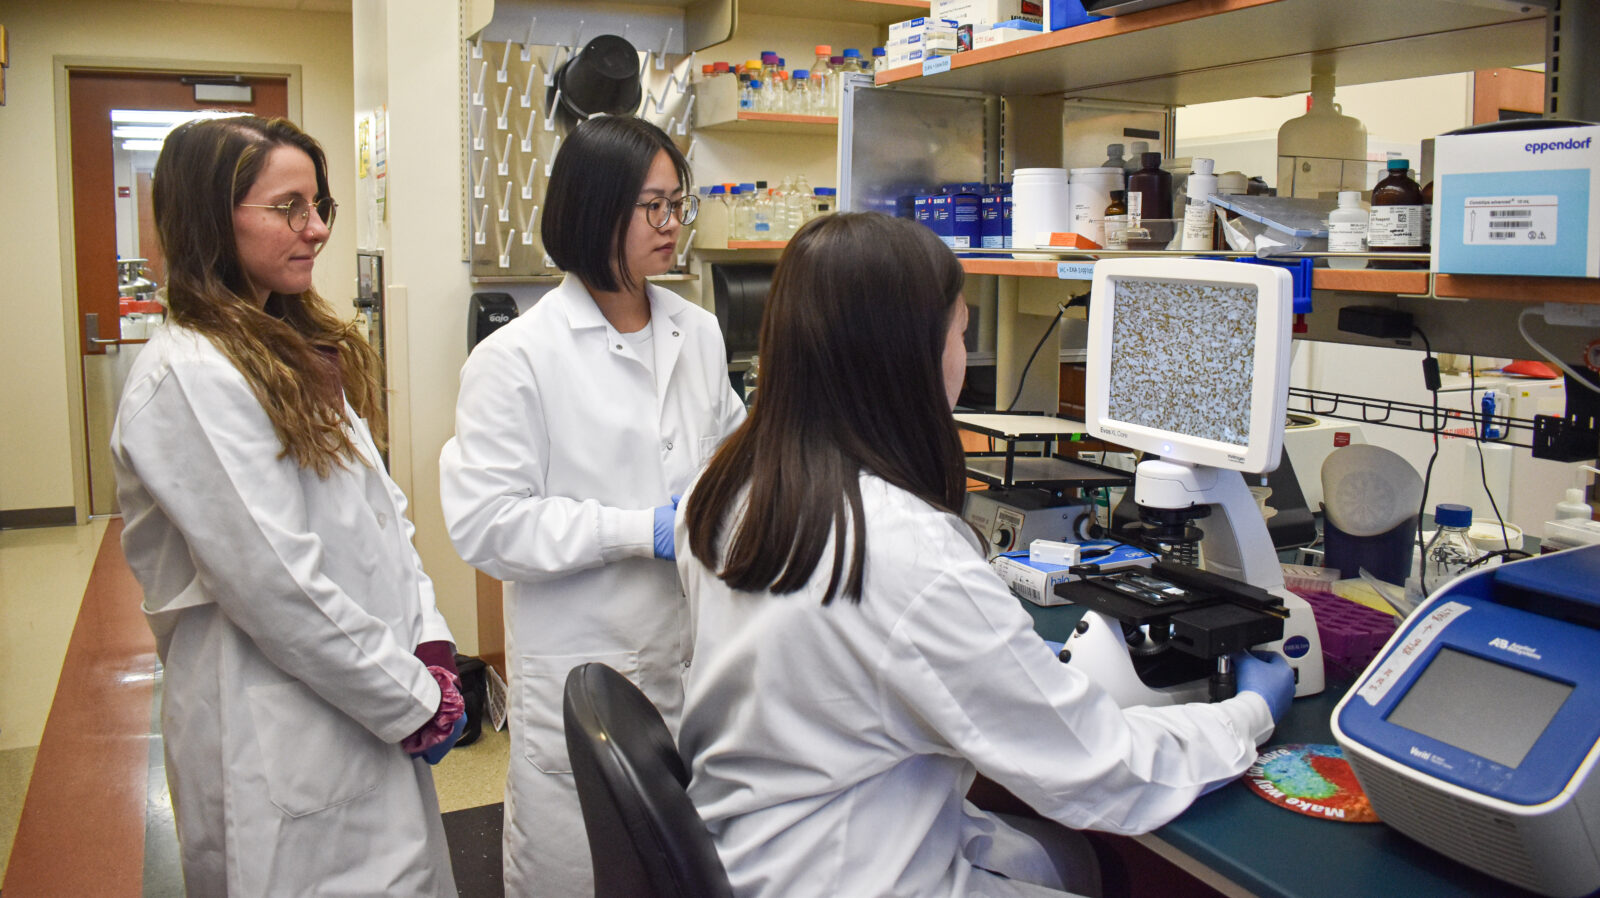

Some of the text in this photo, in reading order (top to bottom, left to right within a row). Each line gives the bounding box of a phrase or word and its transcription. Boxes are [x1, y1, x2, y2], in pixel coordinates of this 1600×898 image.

[1525, 136, 1592, 154] eppendorf
[1488, 637, 1509, 649] AB
[1255, 748, 1292, 766] more
[1252, 779, 1287, 799] way
[1285, 797, 1345, 818] Make
